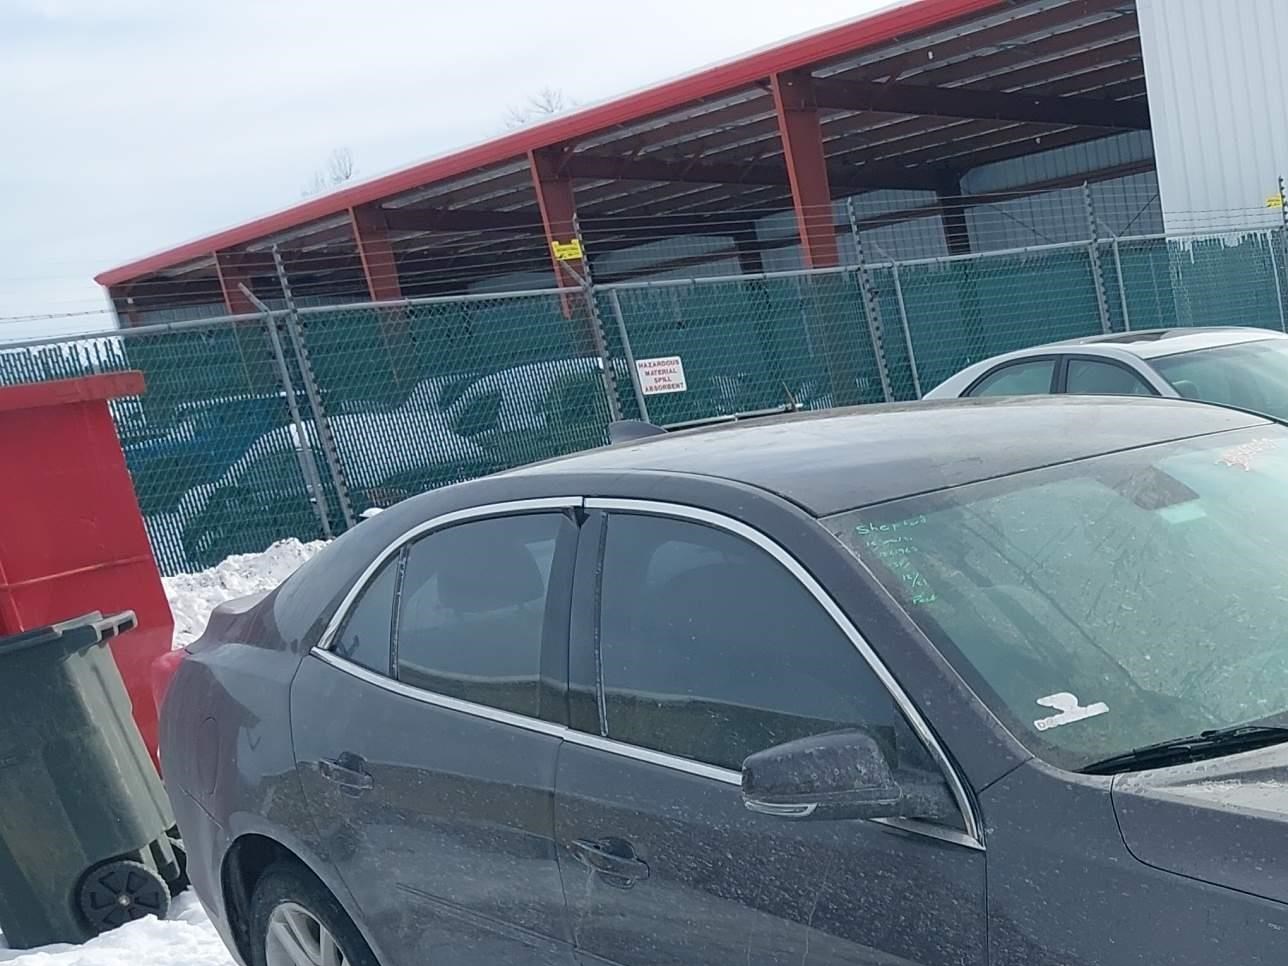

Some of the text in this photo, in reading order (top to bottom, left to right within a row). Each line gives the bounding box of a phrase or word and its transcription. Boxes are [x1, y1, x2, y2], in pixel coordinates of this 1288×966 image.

[638, 359, 680, 368] HAZARDOUS
[645, 367, 678, 376] MATERIAL
[654, 376, 673, 384] SPILL
[645, 382, 685, 393] ABSORBENT
